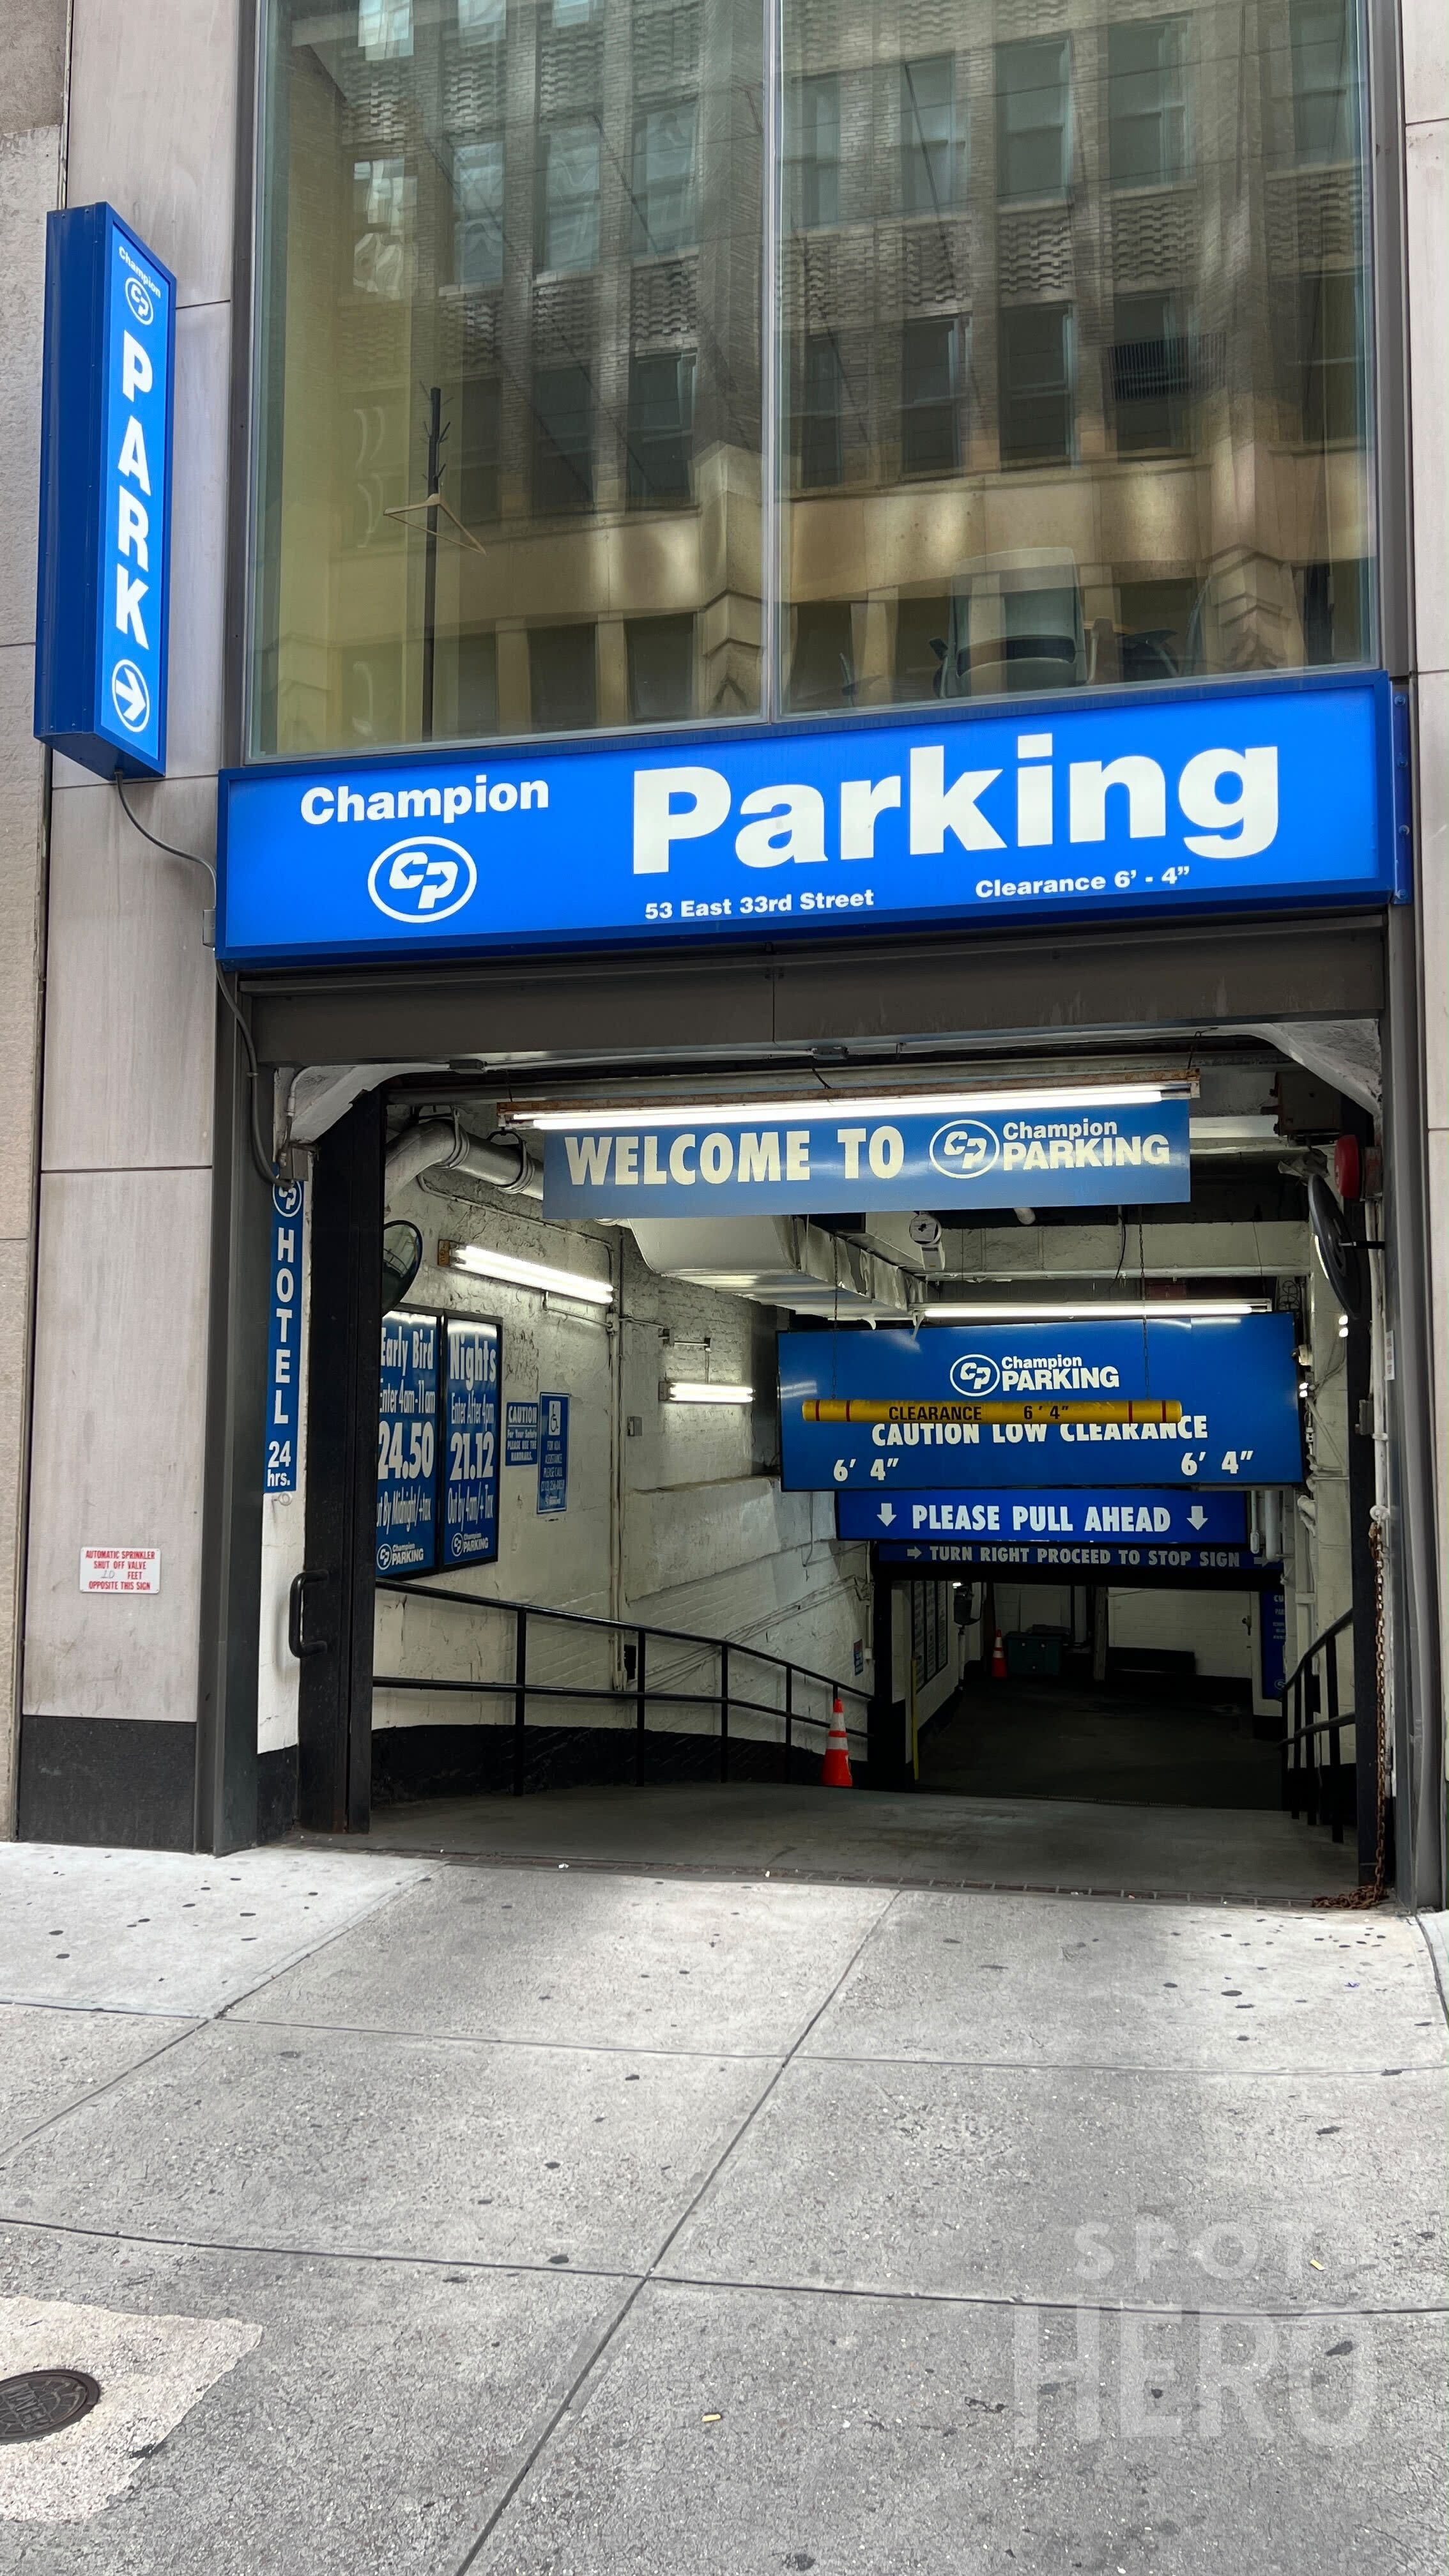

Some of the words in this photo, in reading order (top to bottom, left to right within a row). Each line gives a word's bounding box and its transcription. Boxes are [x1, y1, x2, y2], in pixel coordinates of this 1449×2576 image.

[119, 246, 161, 298] Champion
[116, 329, 153, 650] PARK
[300, 774, 549, 825] Champion
[633, 733, 1279, 875] Parking
[976, 875, 1106, 898] Clearance
[645, 902, 673, 920] 53
[680, 898, 732, 918] East
[739, 894, 792, 914] 33rd
[800, 889, 874, 910] Street
[1003, 1118, 1118, 1140] Champion
[564, 1131, 810, 1186] WELCOME
[837, 1126, 905, 1179] TO
[1003, 1134, 1170, 1170] PARKING
[273, 1227, 295, 1425] HOTEL
[380, 1326, 408, 1376] Early
[412, 1328, 434, 1370] Bird
[450, 1333, 496, 1391] Nights
[1001, 1354, 1082, 1370] Champion
[1002, 1366, 1119, 1392] PARKING
[451, 1392, 466, 1425] Enter
[467, 1390, 482, 1425] After
[482, 1393, 494, 1431] 4pm
[509, 1406, 537, 1423] CAUTION
[889, 1406, 982, 1420] CLEARANCE
[872, 1423, 980, 1446] CAUTION
[992, 1423, 1048, 1443] LOW
[1060, 1415, 1209, 1442] CLEARANCE
[267, 1440, 291, 1468] 24
[378, 1421, 434, 1480] 24.50
[449, 1432, 494, 1480] 21.12
[267, 1468, 290, 1487] hrs.
[383, 1491, 392, 1535] By
[448, 1487, 457, 1524] Out
[912, 1505, 999, 1530] PLEASE
[1013, 1506, 1073, 1531] PULL
[1084, 1506, 1171, 1532] AHEAD
[86, 1551, 119, 1559] AUTOMATIC
[122, 1551, 155, 1559] SPRINKLER
[392, 1548, 424, 1566] PARKING
[463, 1537, 489, 1553] PARKING
[930, 1545, 972, 1561] TURN
[980, 1546, 1029, 1563] RIGHT
[1037, 1547, 1111, 1565] PROCEED
[1118, 1549, 1140, 1565] TO
[1148, 1548, 1192, 1566] STOP
[1199, 1547, 1239, 1567] SIGN
[114, 1561, 125, 1569] OFF
[128, 1561, 146, 1569] VALVE
[128, 1571, 142, 1579] FEET
[89, 1581, 118, 1590] OPPOSITE
[121, 1581, 134, 1590] THIS
[136, 1582, 150, 1590] SIGN
